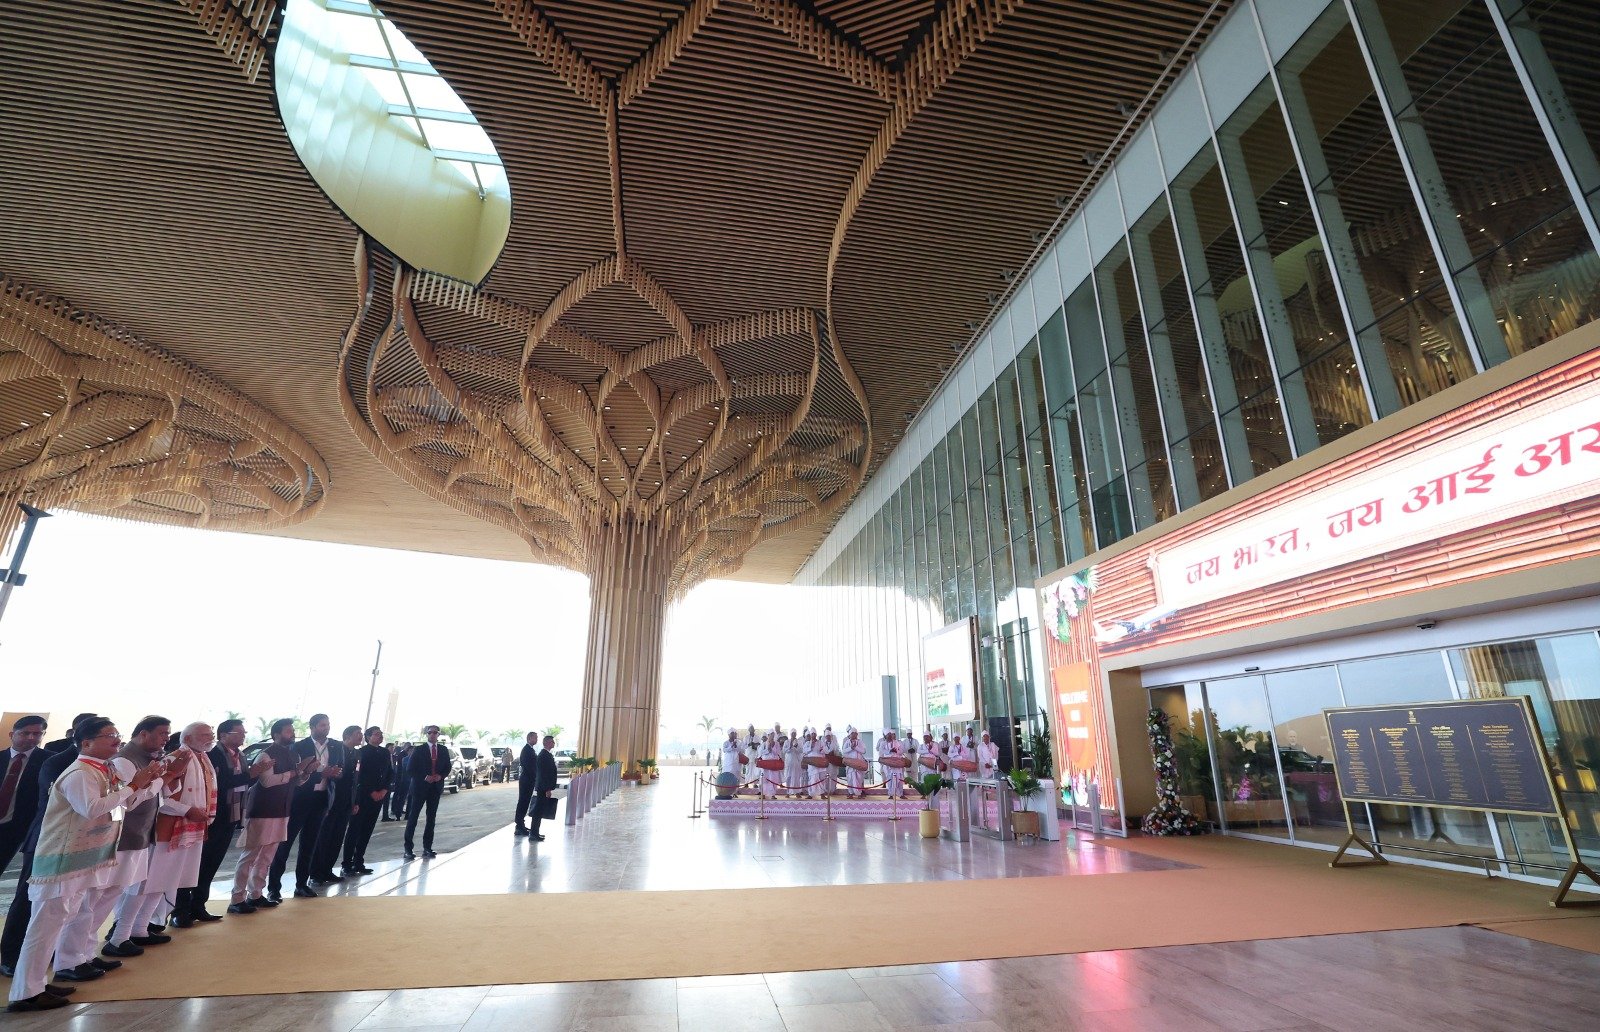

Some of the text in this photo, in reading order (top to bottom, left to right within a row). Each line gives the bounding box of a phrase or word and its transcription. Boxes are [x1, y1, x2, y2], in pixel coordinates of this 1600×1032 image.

[1186, 555, 1220, 585] जय
[1233, 527, 1311, 571] भारत,
[1326, 498, 1384, 539] जय
[1402, 443, 1503, 515] आई
